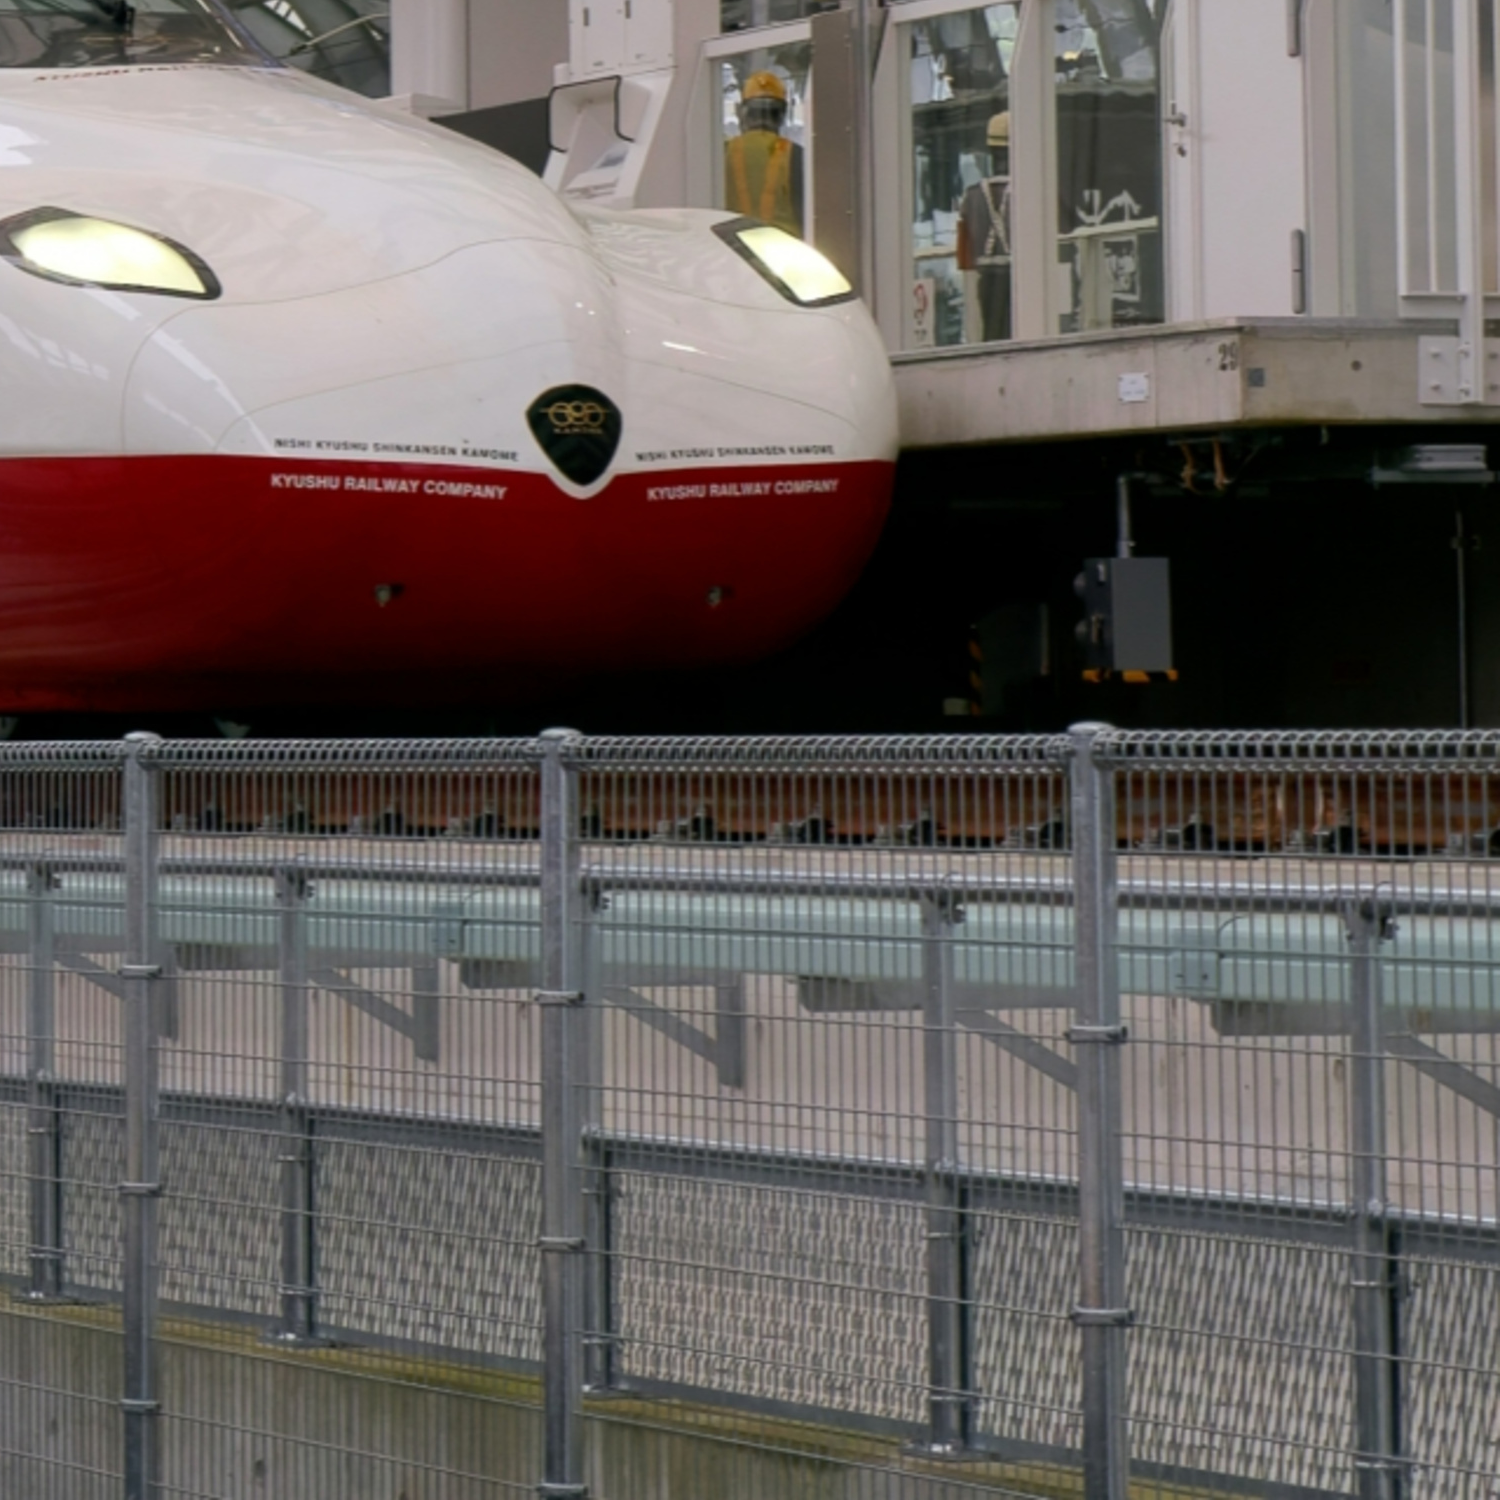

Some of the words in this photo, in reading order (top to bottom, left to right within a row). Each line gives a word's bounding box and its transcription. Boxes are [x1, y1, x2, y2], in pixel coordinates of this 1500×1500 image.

[273, 437, 312, 450] NISHI
[315, 439, 369, 453] KYUSHU
[372, 442, 457, 457] SHINKANSEN
[460, 446, 519, 462] KAMOME
[635, 451, 668, 463] NISHI
[671, 448, 715, 461] KYUSHU
[717, 445, 786, 459] SHINKANSEN
[788, 444, 835, 457] KAMOME
[270, 472, 341, 491] KYUSHU
[343, 475, 421, 495] RAILWAY
[423, 479, 508, 501] COMPANY
[646, 484, 706, 501] KYUSHU
[708, 481, 772, 499] RAILWAY
[773, 477, 839, 496] COMPANY
